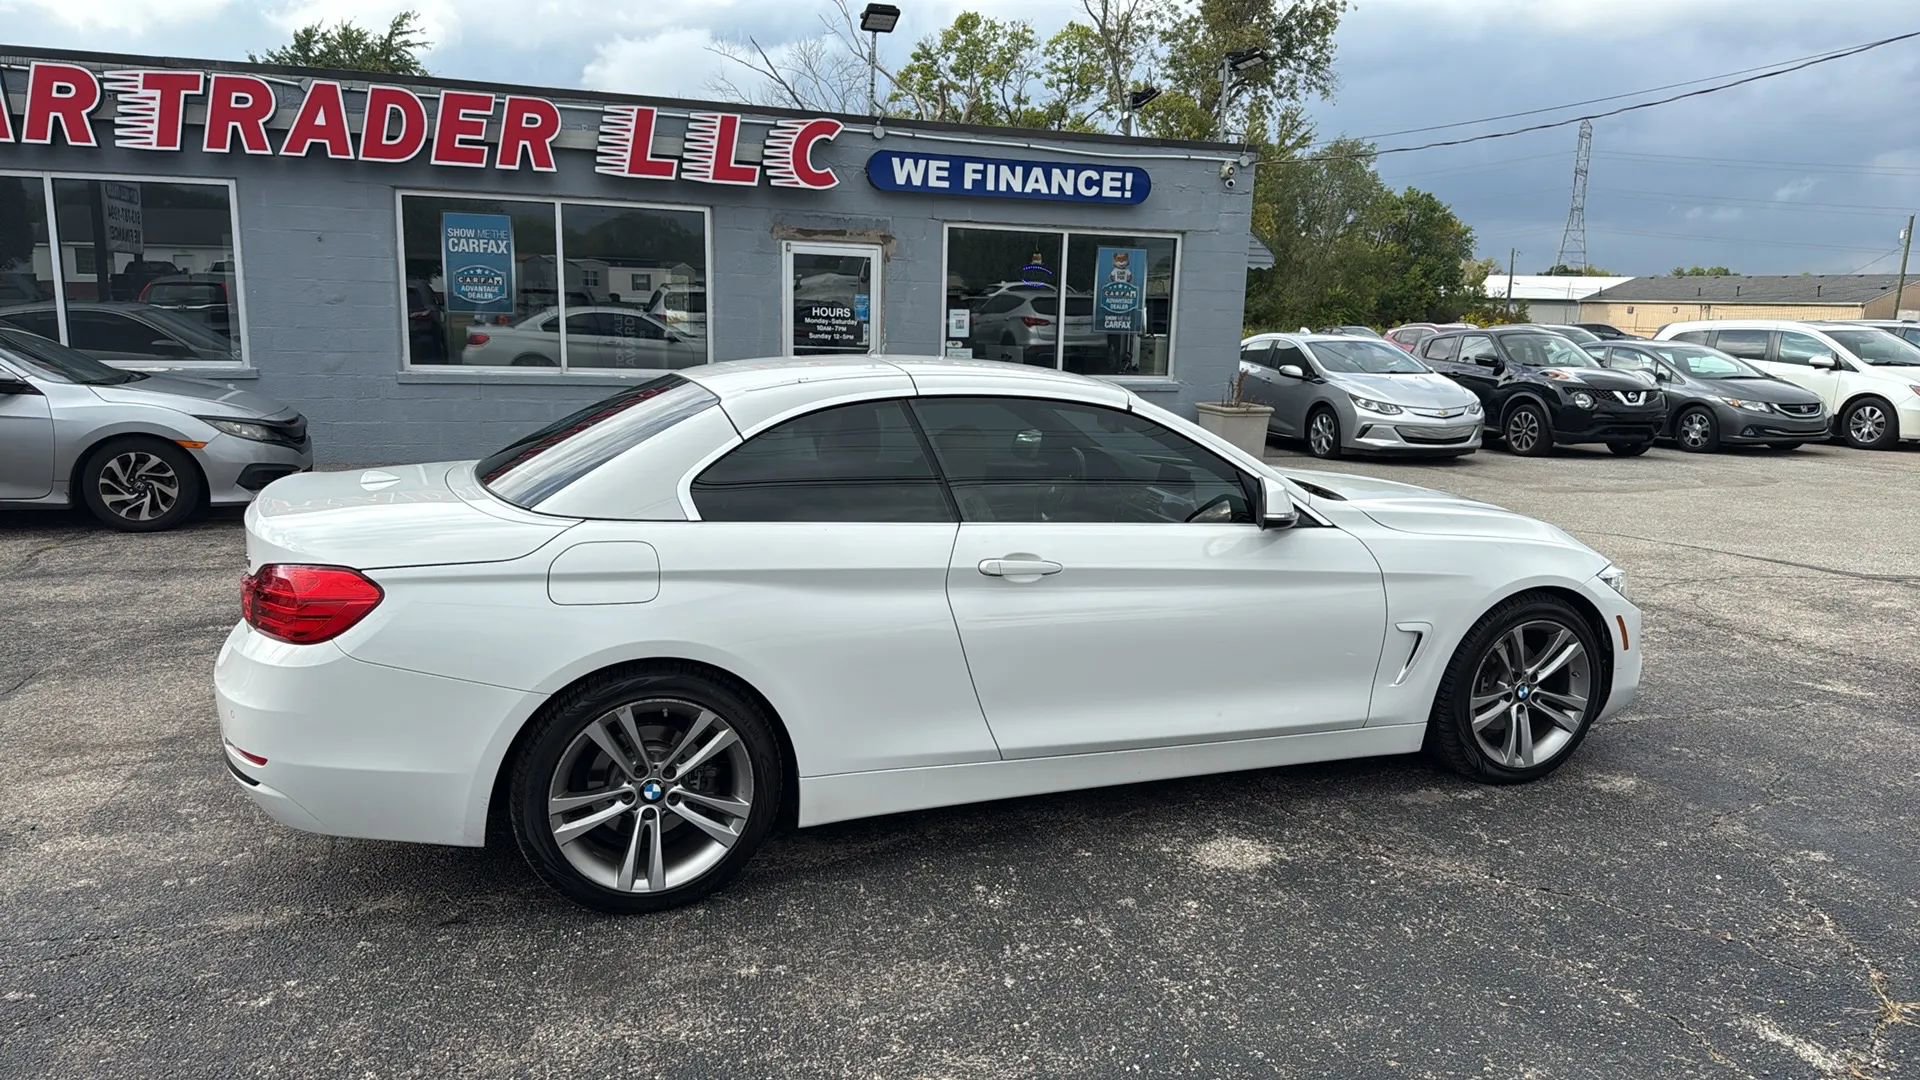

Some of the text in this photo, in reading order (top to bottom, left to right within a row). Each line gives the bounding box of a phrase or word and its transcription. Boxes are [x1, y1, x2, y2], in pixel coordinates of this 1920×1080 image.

[0, 60, 846, 190] R TRADER LLC
[891, 156, 1134, 199] WE FINANCE!
[447, 227, 475, 238] SHOW
[448, 237, 508, 254] CARFAX
[461, 285, 499, 293] ADVANTAGE
[467, 291, 494, 299] DEALER
[811, 306, 851, 318] HOURS
[804, 317, 858, 326] Monday-Saturday
[1104, 320, 1131, 329] CARFAX
[808, 332, 832, 341] Sunday
